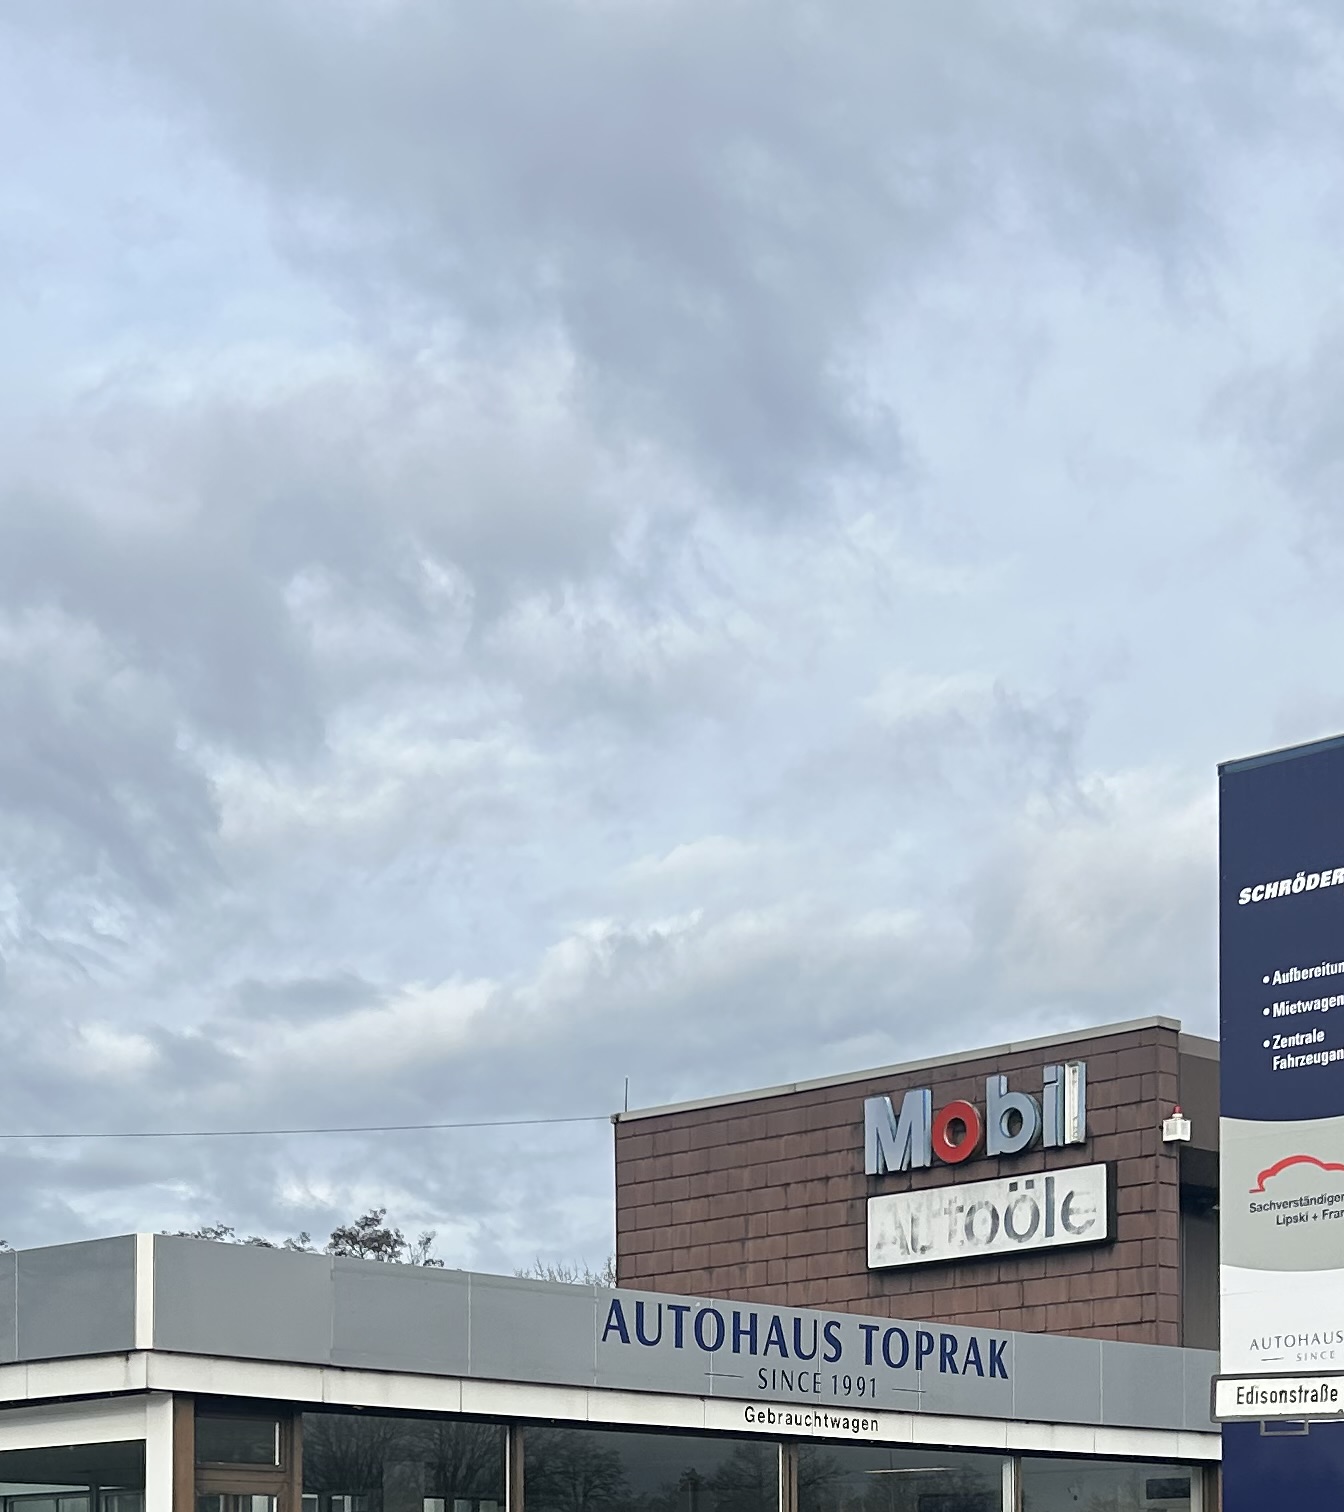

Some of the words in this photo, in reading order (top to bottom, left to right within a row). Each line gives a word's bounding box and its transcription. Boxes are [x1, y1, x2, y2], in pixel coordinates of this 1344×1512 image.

[1272, 993, 1344, 1018] Mietwagen
[1272, 1029, 1325, 1050] Zentrale
[864, 1060, 1088, 1176] Mobil
[1276, 1212, 1309, 1227] Lipski
[602, 1298, 843, 1364] AUTOHAUS
[858, 1323, 1010, 1380] TOPRAK
[1250, 1330, 1344, 1351] AUTOHAUS
[1296, 1351, 1335, 1362] SINCE
[757, 1366, 823, 1395] SINCE
[831, 1373, 878, 1398] 1991
[1236, 1384, 1338, 1405] Edisonstraße
[744, 1404, 880, 1433] Gebrauchtwagen
